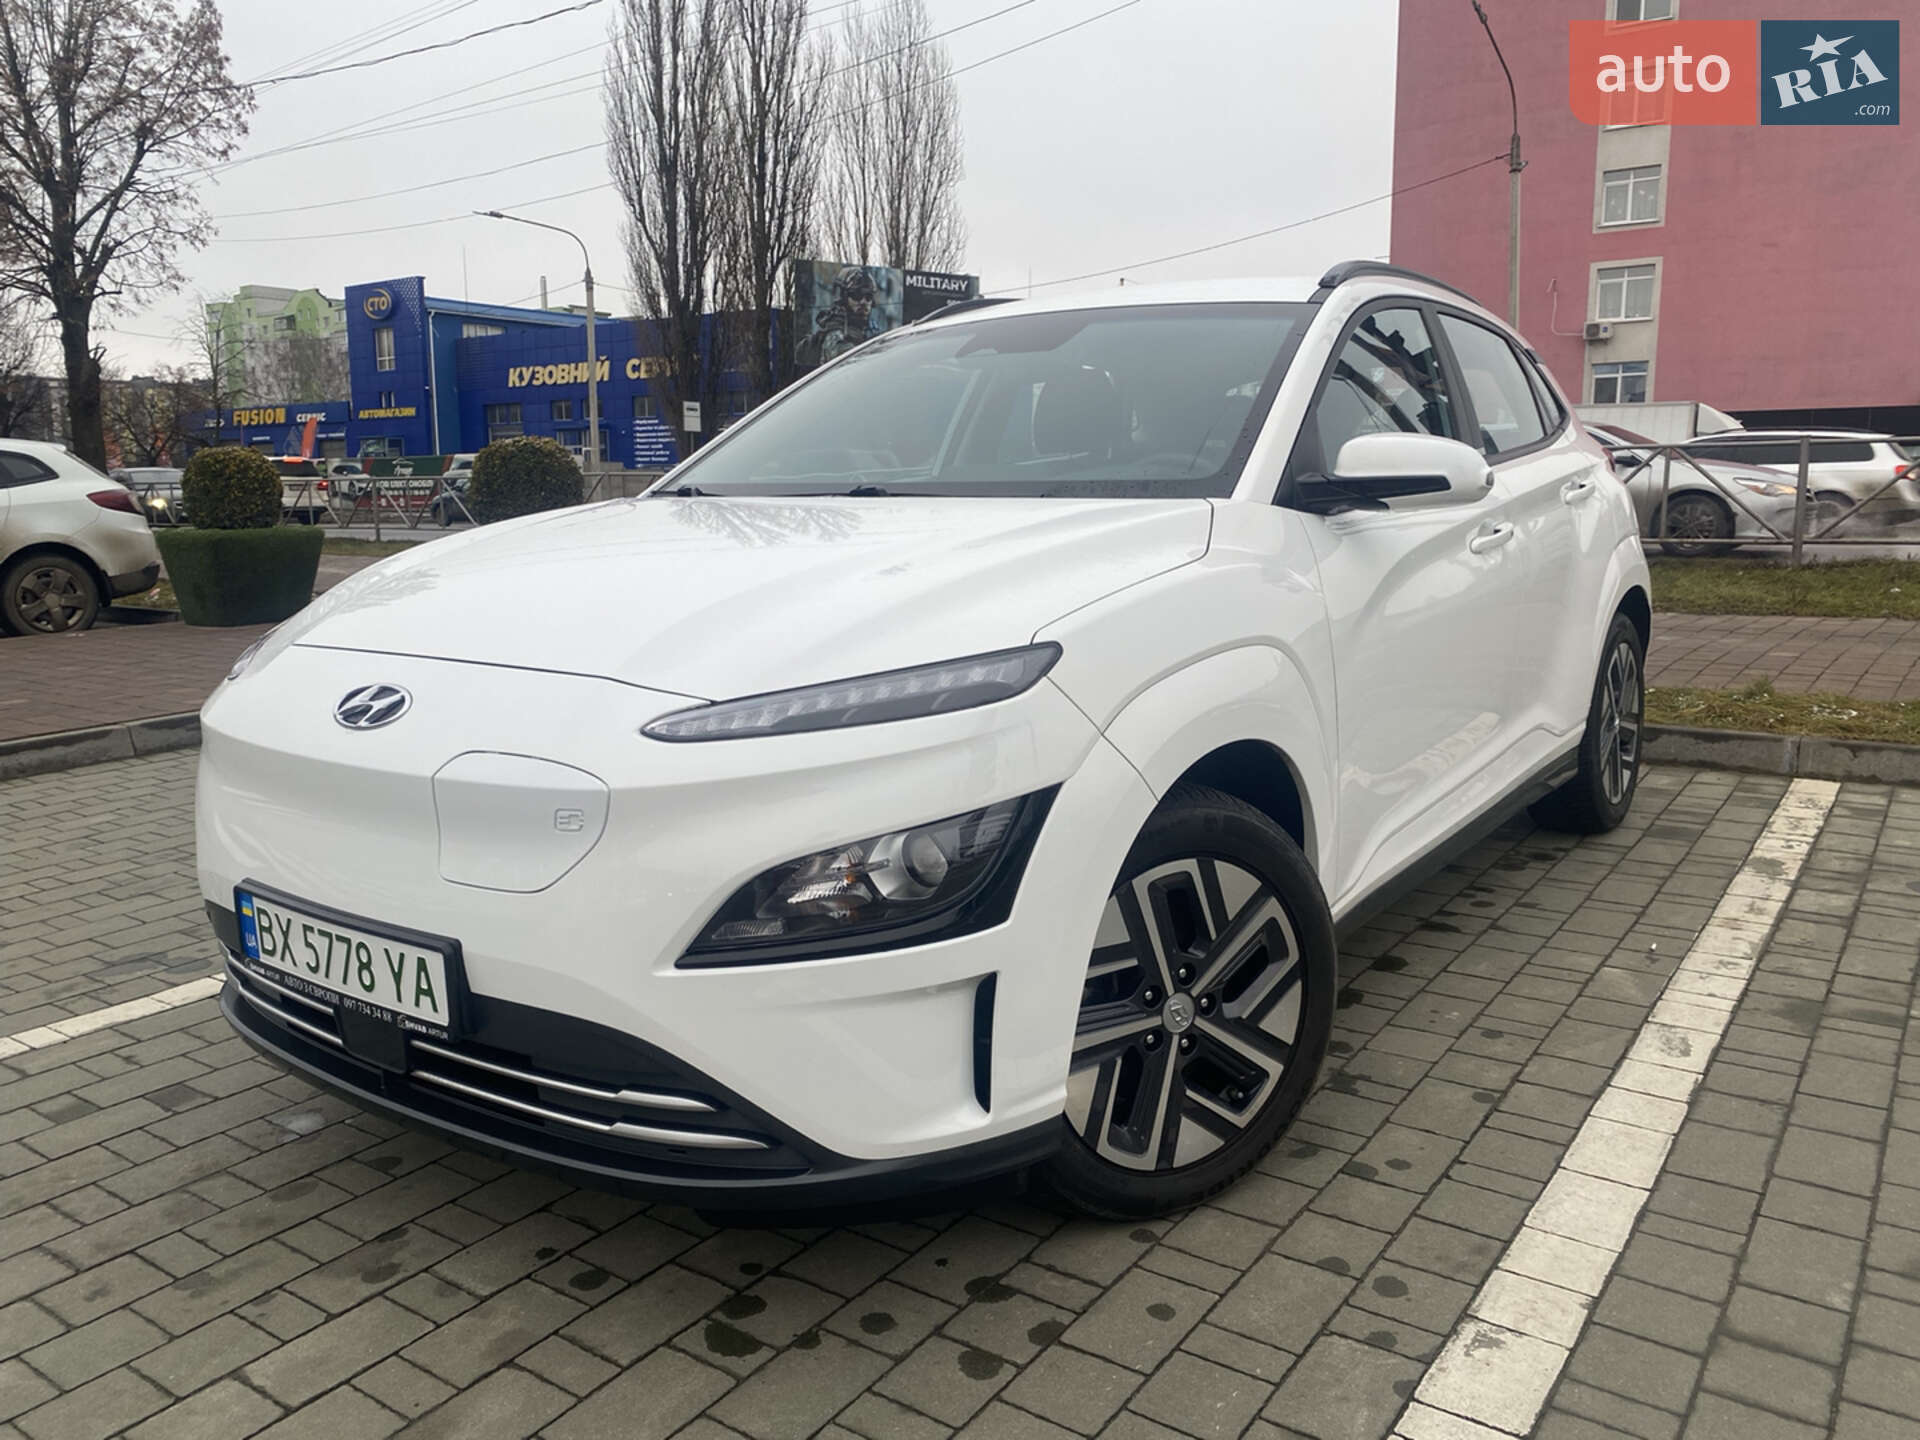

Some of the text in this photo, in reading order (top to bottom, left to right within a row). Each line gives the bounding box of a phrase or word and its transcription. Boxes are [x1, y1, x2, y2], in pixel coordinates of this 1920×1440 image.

[906, 275, 968, 291] MILITARY
[367, 297, 388, 311] СТО
[508, 355, 611, 387] КУЗОВНИЙ
[232, 407, 286, 426] FUSION
[246, 933, 257, 947] UA
[256, 906, 439, 1013] BX 5778 YA
